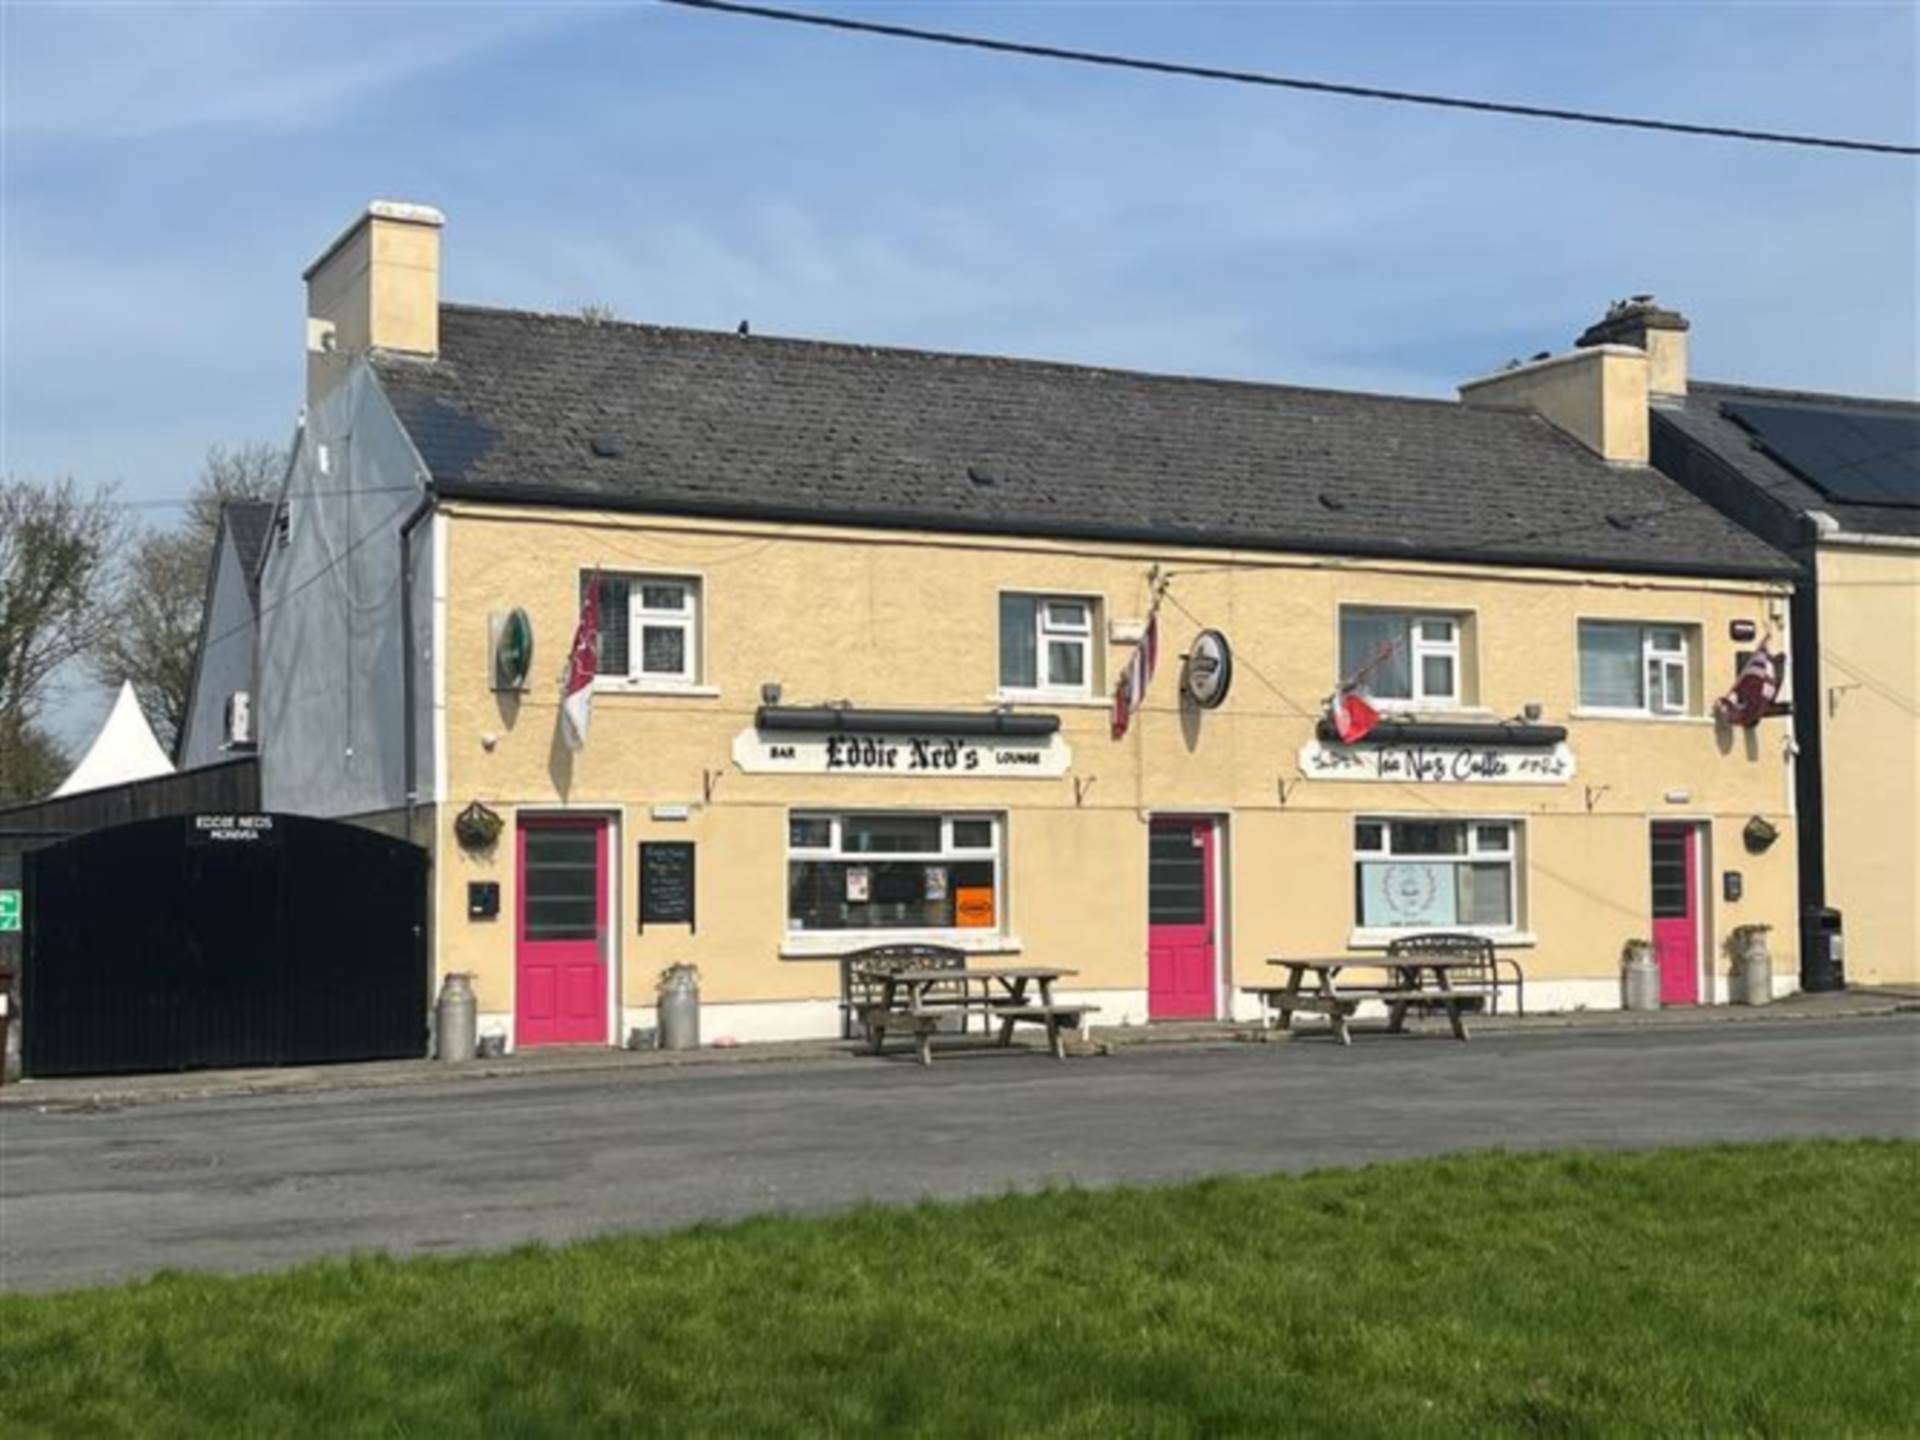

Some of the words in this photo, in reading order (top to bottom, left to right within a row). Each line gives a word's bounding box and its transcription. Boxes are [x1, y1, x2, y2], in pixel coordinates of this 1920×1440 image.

[770, 746, 796, 759] BAR
[826, 734, 898, 770] Eddie
[908, 736, 979, 770] Ned's
[996, 751, 1041, 765] LOUNGE
